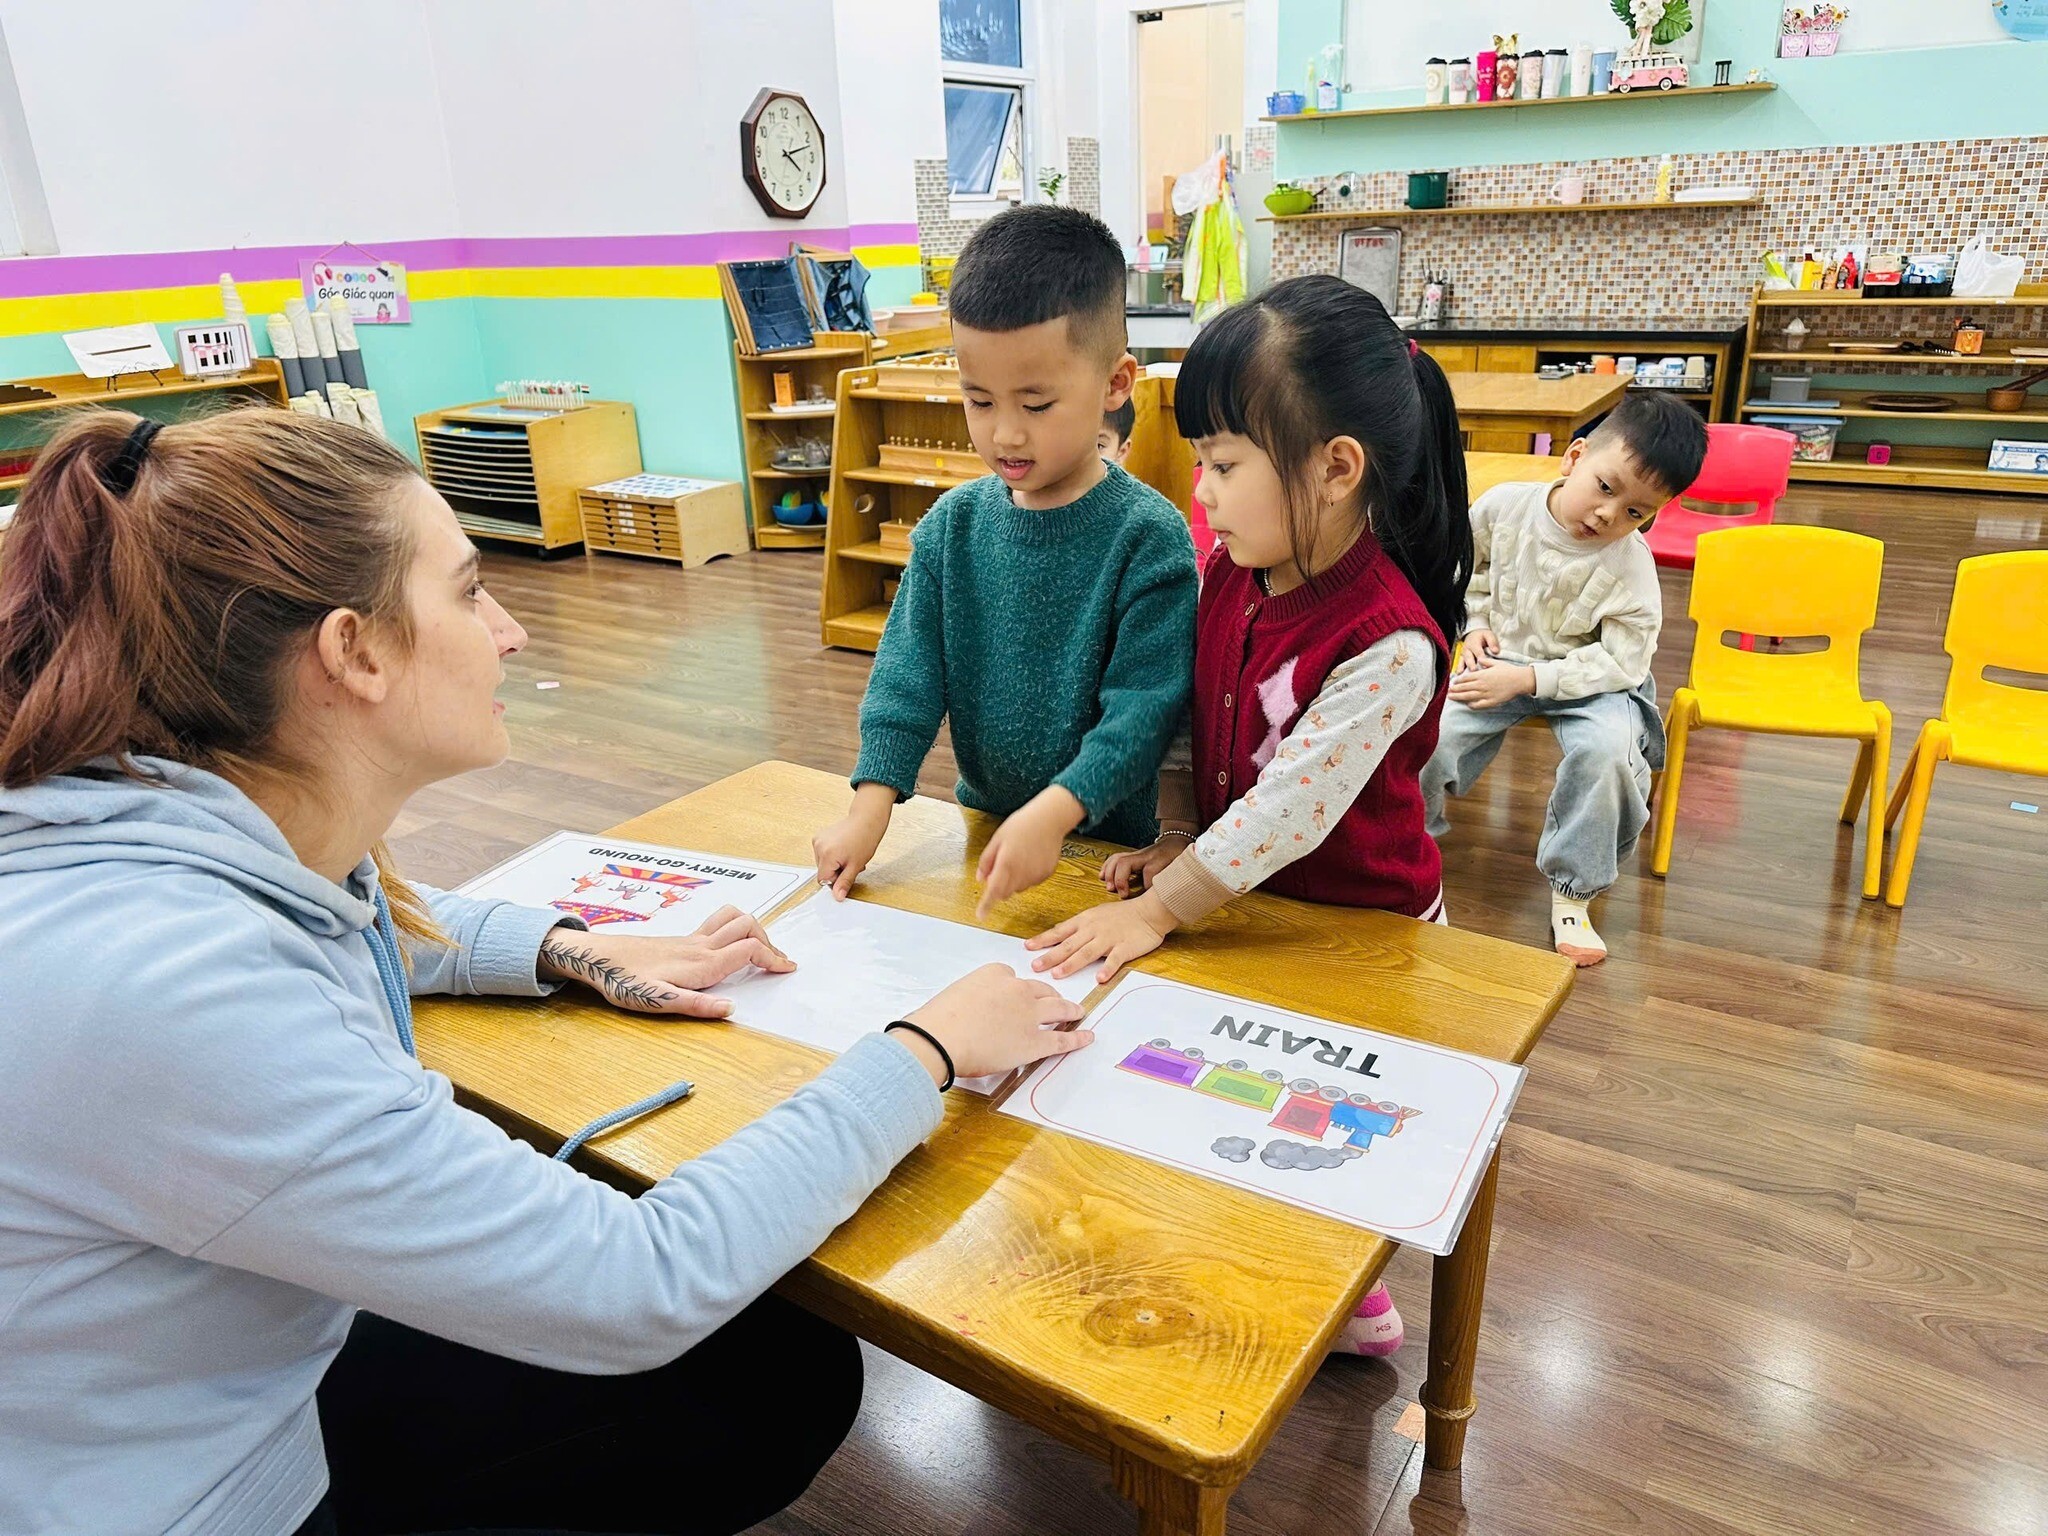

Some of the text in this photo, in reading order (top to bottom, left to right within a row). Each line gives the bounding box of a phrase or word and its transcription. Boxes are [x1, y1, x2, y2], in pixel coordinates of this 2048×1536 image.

[768, 112, 776, 124] 11
[780, 107, 789, 120] 12
[759, 126, 768, 138] 10
[805, 131, 810, 143] 2
[756, 145, 761, 158] 9
[810, 151, 815, 164] 3
[762, 167, 767, 179] 8
[786, 189, 791, 202] 6
[342, 287, 367, 300] Giác
[369, 291, 395, 302] quan
[588, 848, 757, 881] MERRY-GO-ROUND
[1209, 1014, 1381, 1079] TRAIN
[1375, 1323, 1392, 1333] XS
